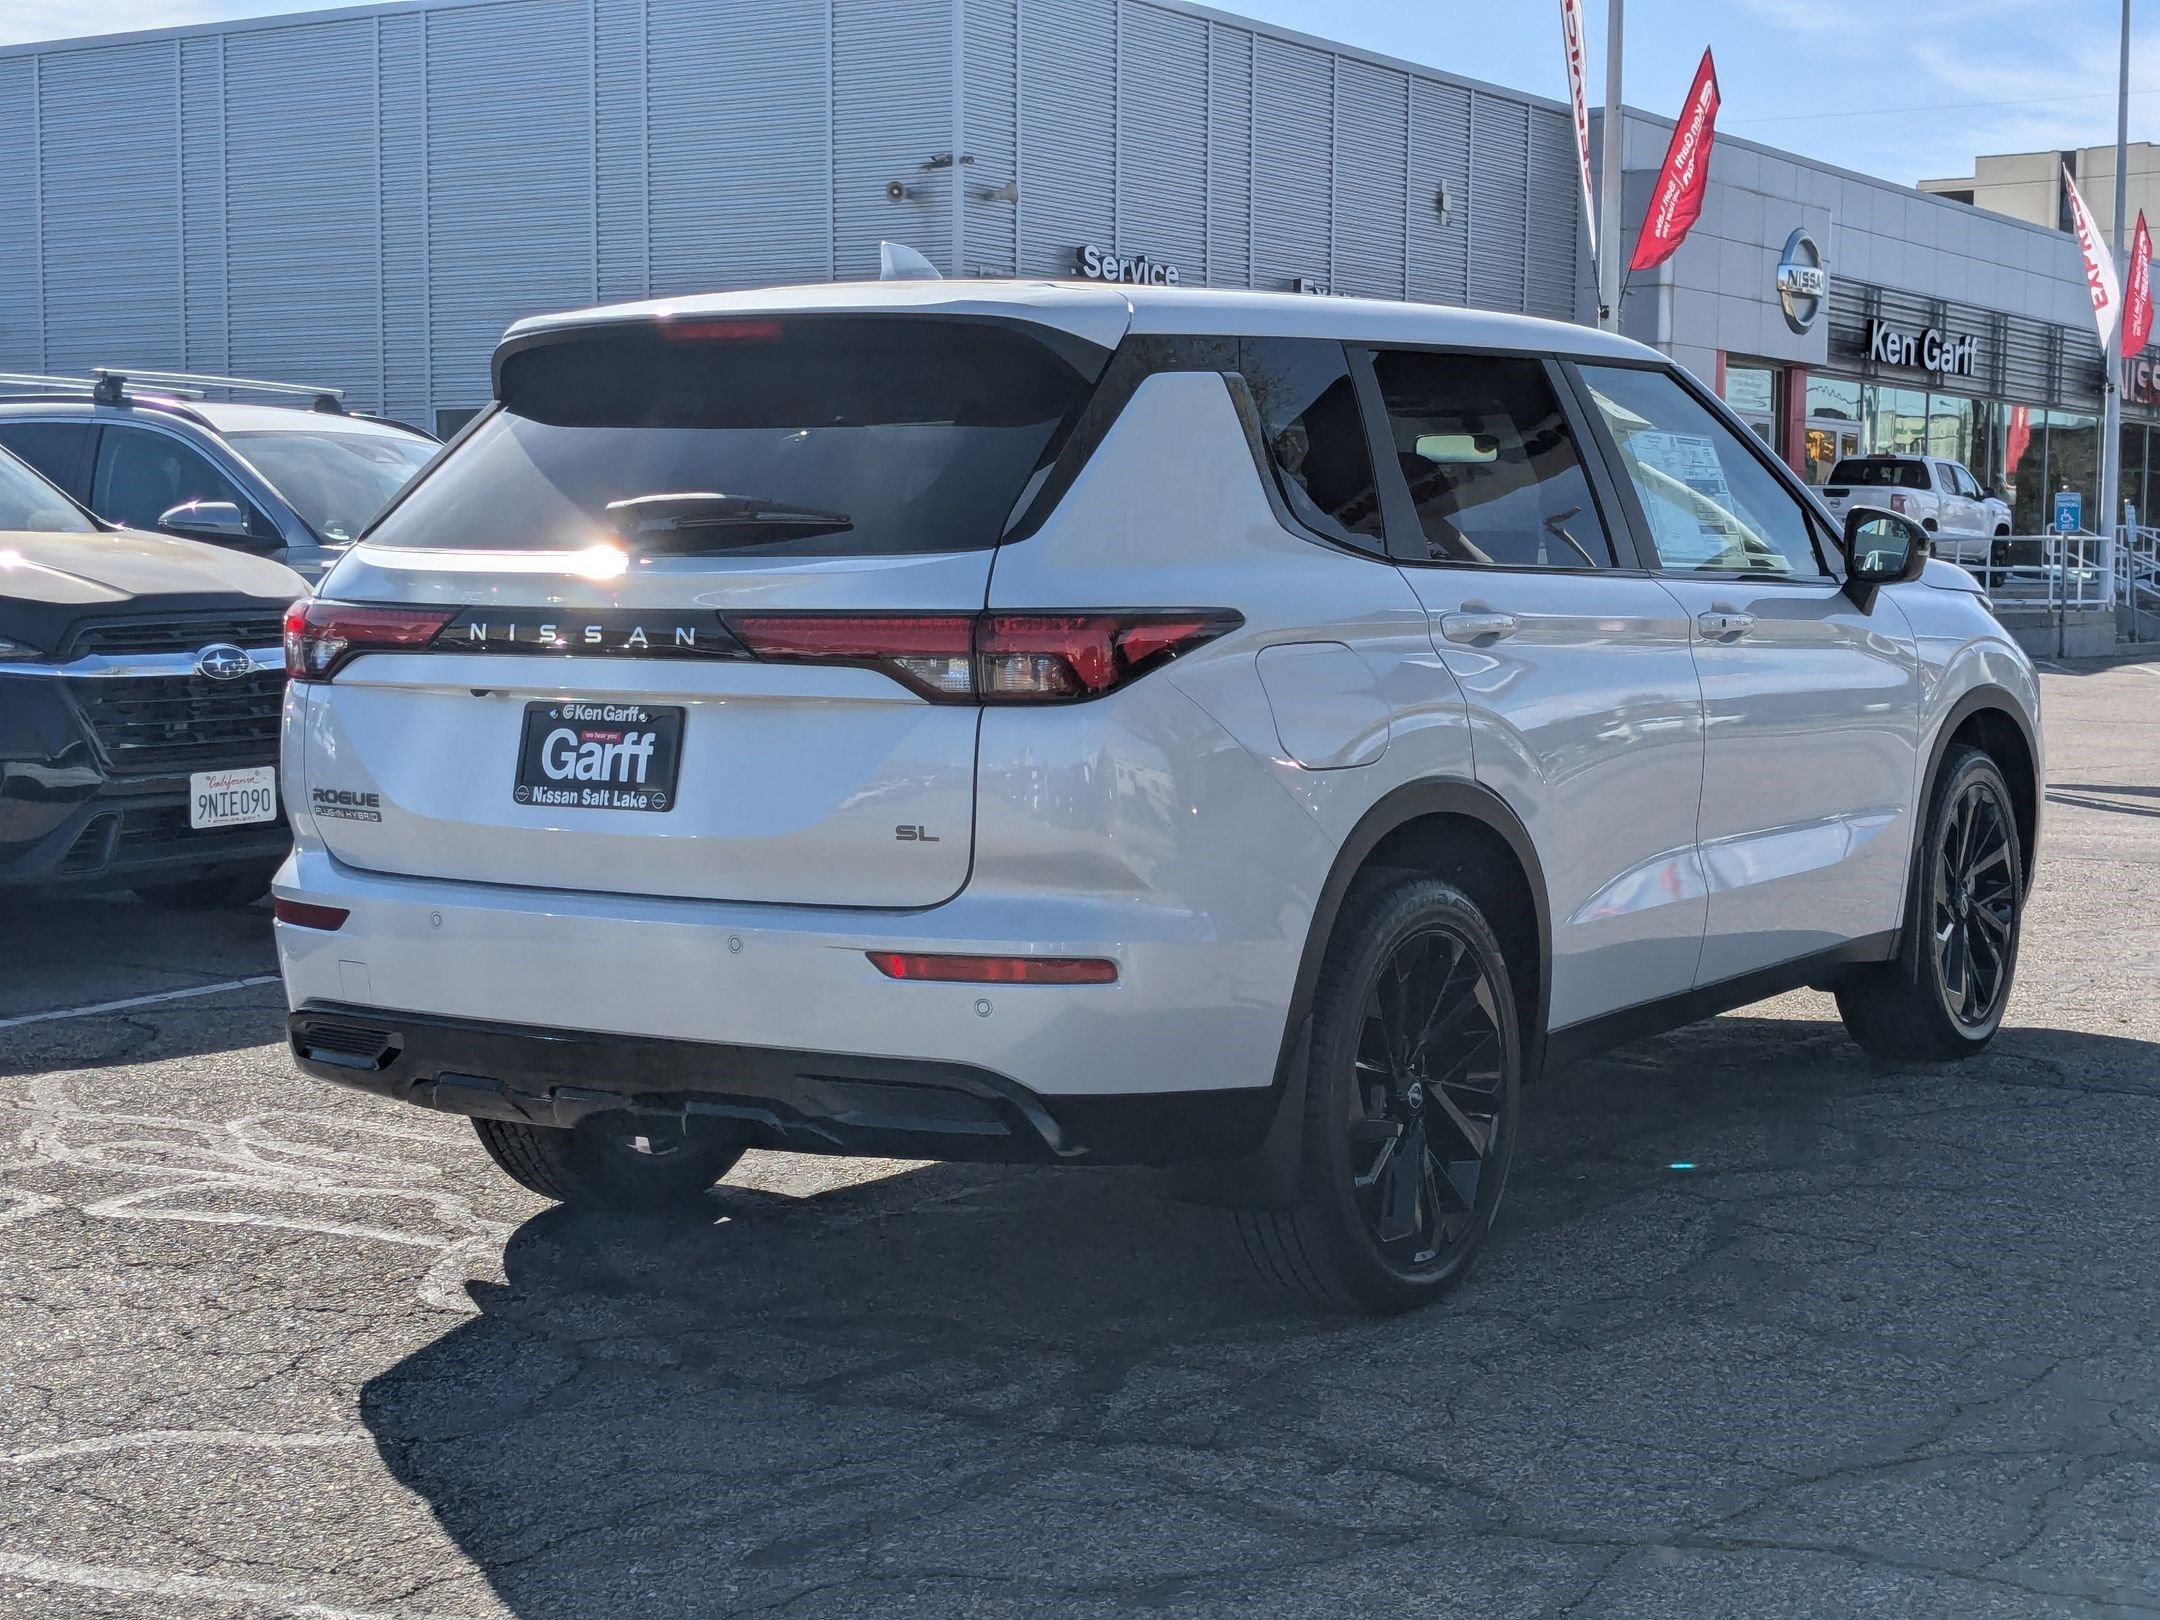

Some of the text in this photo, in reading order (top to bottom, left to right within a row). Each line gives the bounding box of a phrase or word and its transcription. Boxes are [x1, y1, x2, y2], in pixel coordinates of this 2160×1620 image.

[1082, 245, 1180, 286] Service
[1787, 269, 1824, 292] NISSA
[1871, 319, 1978, 375] Ken Garff
[470, 623, 696, 646] NISSAN
[575, 704, 639, 722] Ken Garff
[541, 728, 656, 784] Garff
[198, 788, 271, 820] 9NIE090
[313, 788, 380, 808] ROGUE
[532, 785, 648, 809] Nissan Salt Lake
[896, 825, 940, 841] SL
